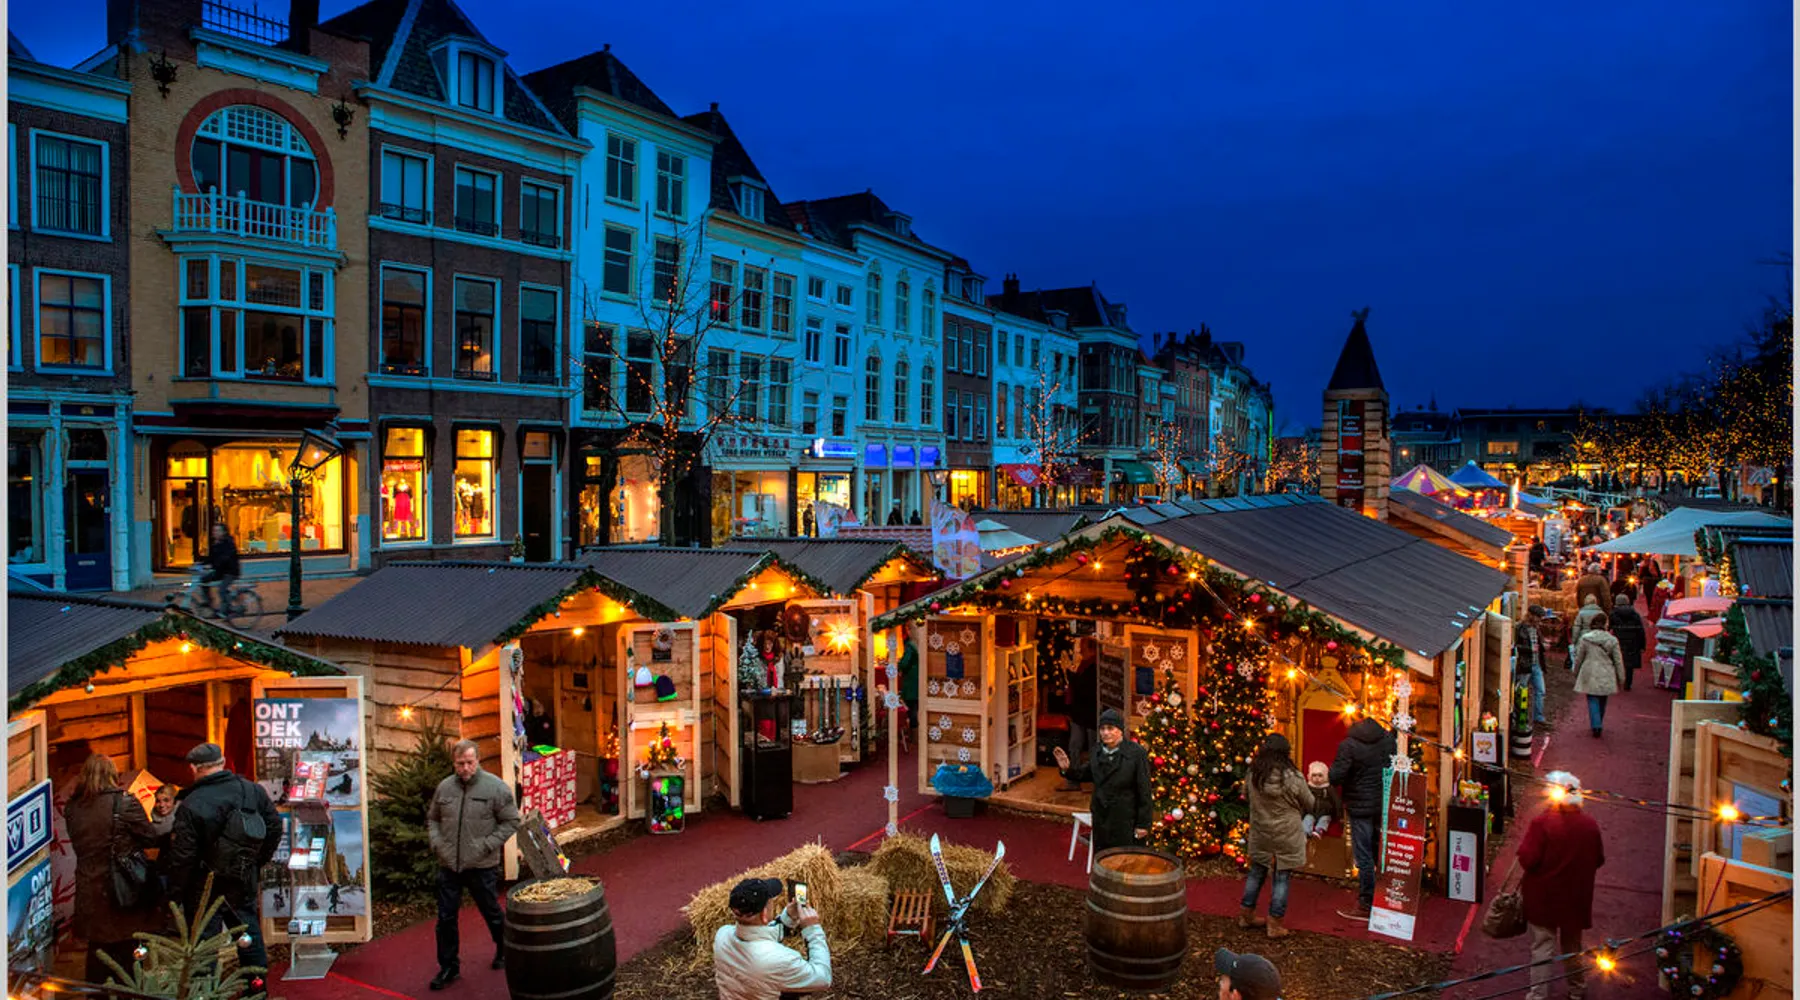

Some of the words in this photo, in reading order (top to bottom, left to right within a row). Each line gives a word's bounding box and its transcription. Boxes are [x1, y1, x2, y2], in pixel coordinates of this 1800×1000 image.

[255, 703, 303, 719] ONT
[255, 721, 302, 737] DEK
[255, 738, 302, 748] LEIDEN
